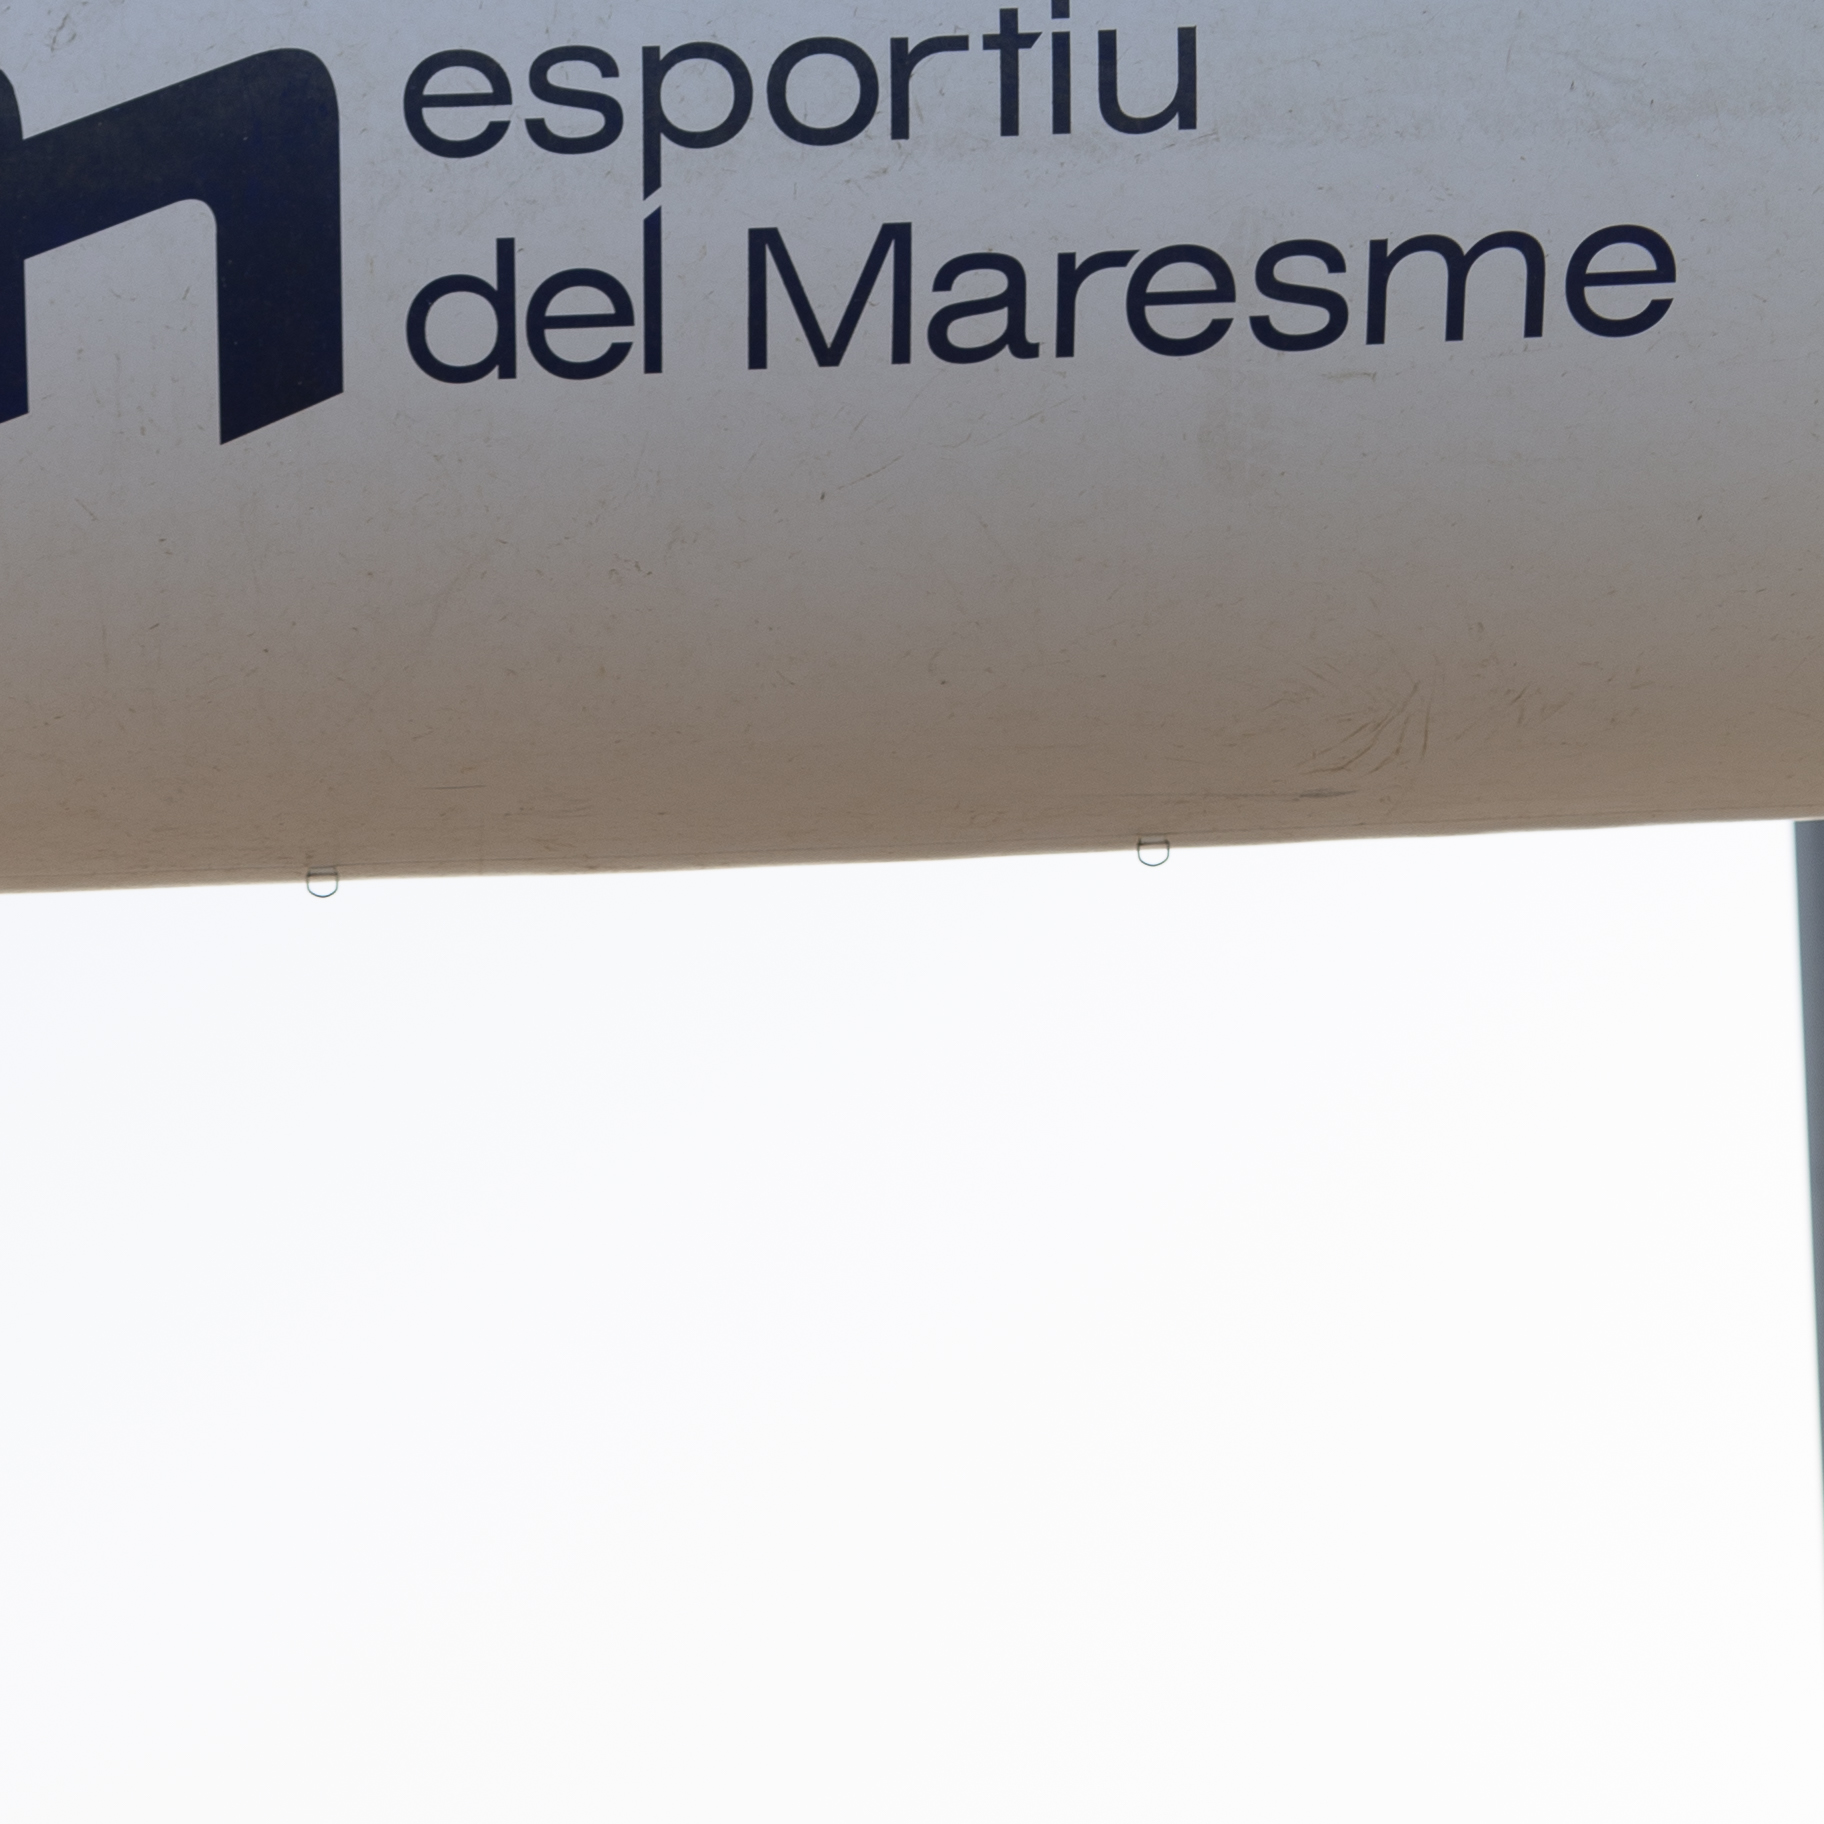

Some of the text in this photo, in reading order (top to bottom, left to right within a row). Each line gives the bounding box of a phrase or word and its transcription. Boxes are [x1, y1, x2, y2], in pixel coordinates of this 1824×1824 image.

[403, 0, 1197, 201] esportiu
[406, 206, 1677, 384] del Maresme
